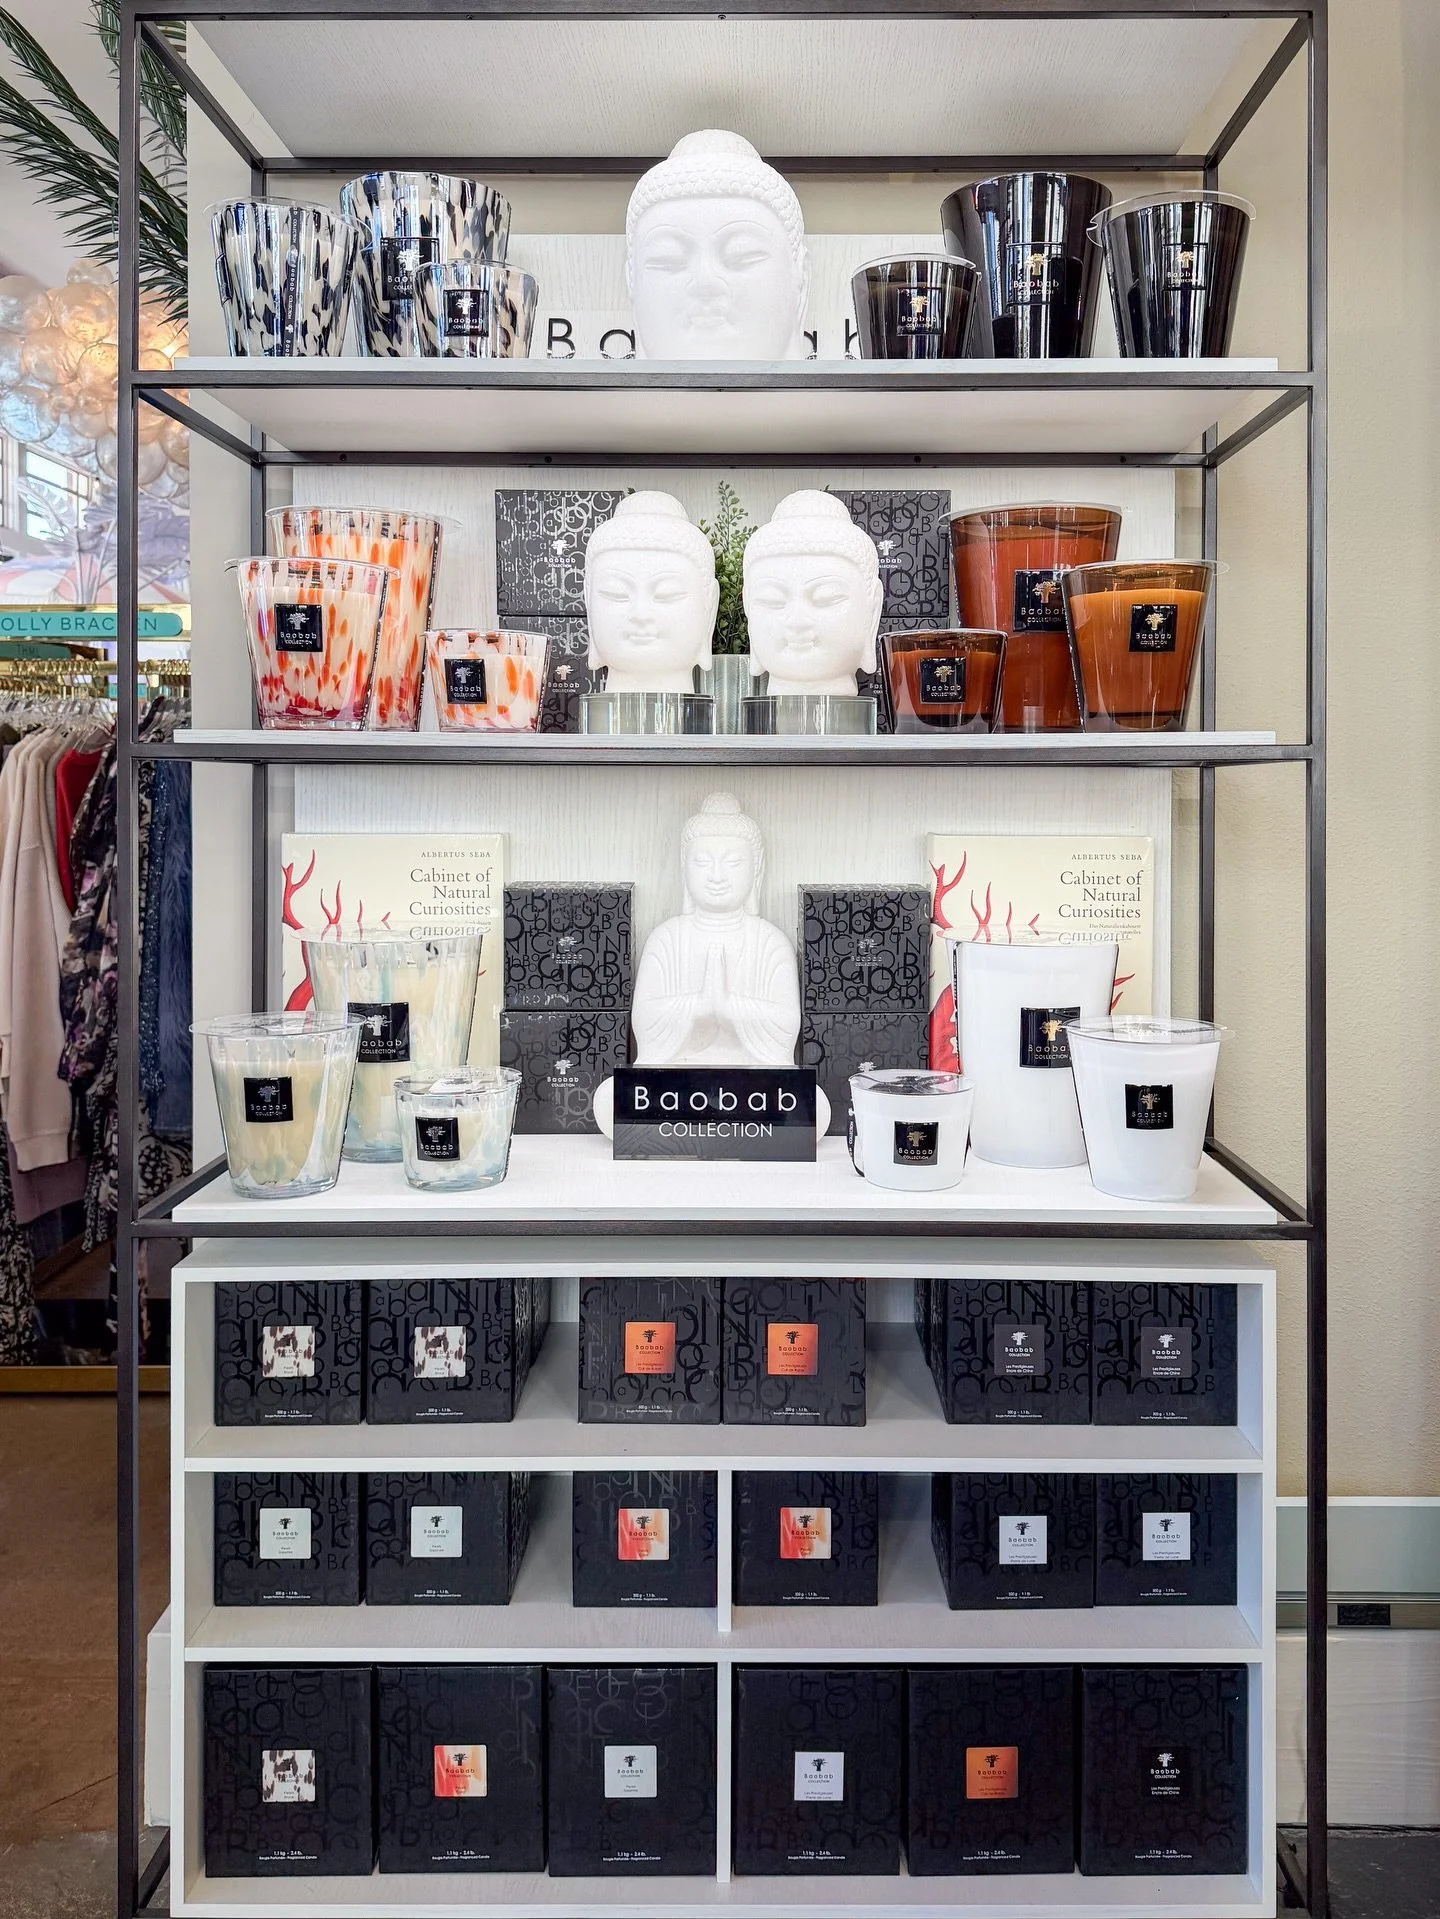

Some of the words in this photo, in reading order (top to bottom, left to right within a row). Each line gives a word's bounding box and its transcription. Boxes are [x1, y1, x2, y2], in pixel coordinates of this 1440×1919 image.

[1013, 280, 1059, 288] Baobab
[0, 617, 52, 631] OLLY
[280, 631, 317, 640] Baobab
[1136, 632, 1172, 640] Baobab
[450, 685, 481, 693] Baobab
[926, 684, 961, 692] Baobab
[410, 867, 470, 883] Cabinet
[475, 866, 493, 883] of
[1060, 869, 1121, 885] Cabinet
[1126, 869, 1144, 885] of
[433, 883, 491, 899] Natural
[1082, 886, 1141, 902] Natural
[409, 901, 491, 916] Curiosities
[1058, 903, 1141, 919] Curiosities
[361, 1038, 402, 1048] aobab
[1028, 1044, 1066, 1053] Baoba
[634, 1085, 797, 1112] Baobab
[659, 1121, 773, 1138] COLLECTION
